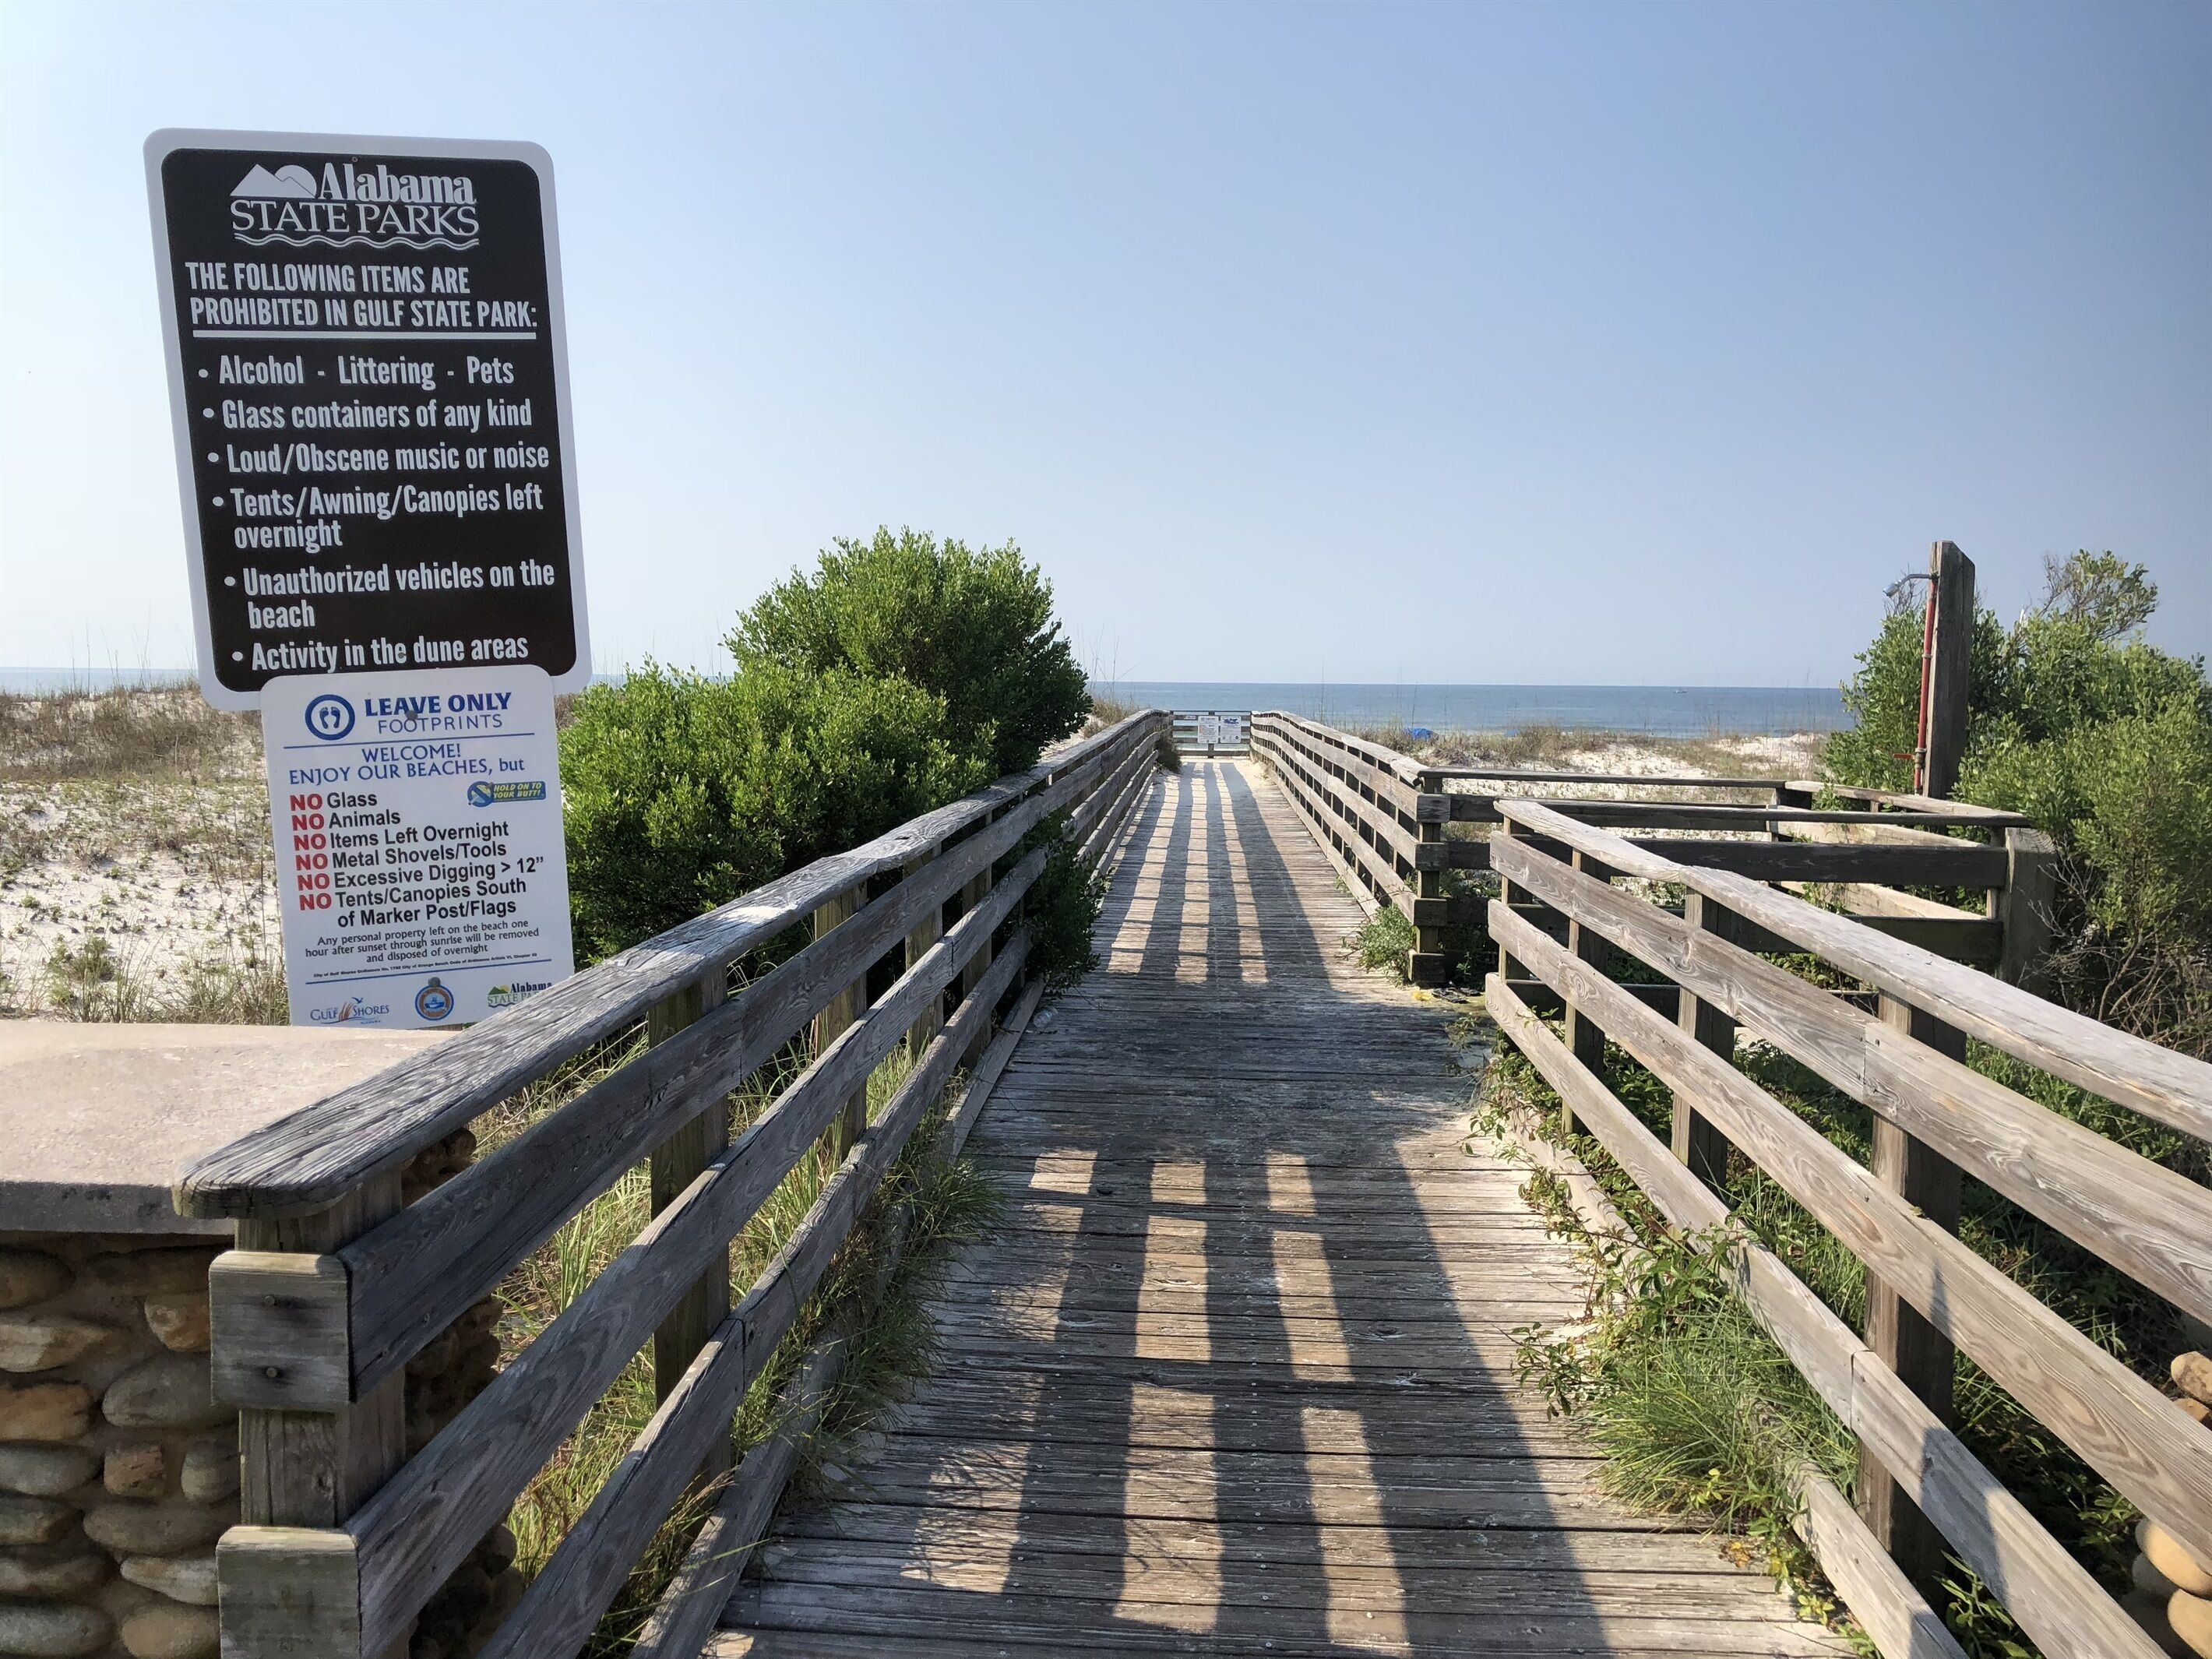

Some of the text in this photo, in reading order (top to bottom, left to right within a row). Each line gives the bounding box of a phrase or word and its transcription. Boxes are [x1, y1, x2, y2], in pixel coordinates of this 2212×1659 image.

[319, 162, 477, 205] Alabama
[230, 199, 479, 235] STATE PARKS
[185, 262, 470, 294] THE FOLLOWING ITEMS ARE
[191, 298, 537, 327] PROHIBITED IN GULF STATE PARK:
[219, 354, 304, 385] Alcohol
[338, 356, 435, 390] Littering
[467, 356, 514, 384] Pets
[223, 398, 531, 433] Glass containers of any kind
[227, 441, 549, 475] Loud/Obscene music or noise
[231, 483, 544, 520] Tents/Awning/Canopies left
[234, 519, 343, 553] overnight
[243, 559, 555, 596] Unauthorized vehicles on the
[248, 599, 315, 629] beach
[251, 635, 528, 674] Activity in the dune areas
[365, 692, 512, 717] LEAVE ONLY
[378, 713, 502, 734] FOOTPRINTS
[361, 743, 461, 763] WELCOME!
[289, 757, 525, 786] ENJOY OUR BEACHES, but
[290, 791, 378, 812] NO Glass
[291, 808, 401, 831] NO Animals
[294, 820, 509, 851] NO Items Left Overnight
[295, 842, 507, 871] NO Metal Shovels/Tools
[297, 872, 330, 891] NO
[334, 867, 423, 889] Excessive
[429, 861, 496, 882] Digging
[299, 877, 527, 911] NO Tents/Canopies South
[337, 898, 516, 928] of Marker Post/Flags
[305, 928, 539, 957] hour after sunset through sunrise will be removed
[317, 920, 529, 946] Any personal property left on the beach one
[366, 943, 488, 963] and disposed of overnight
[310, 1005, 389, 1021] GULF SHORES
[488, 993, 518, 1005] STATE
